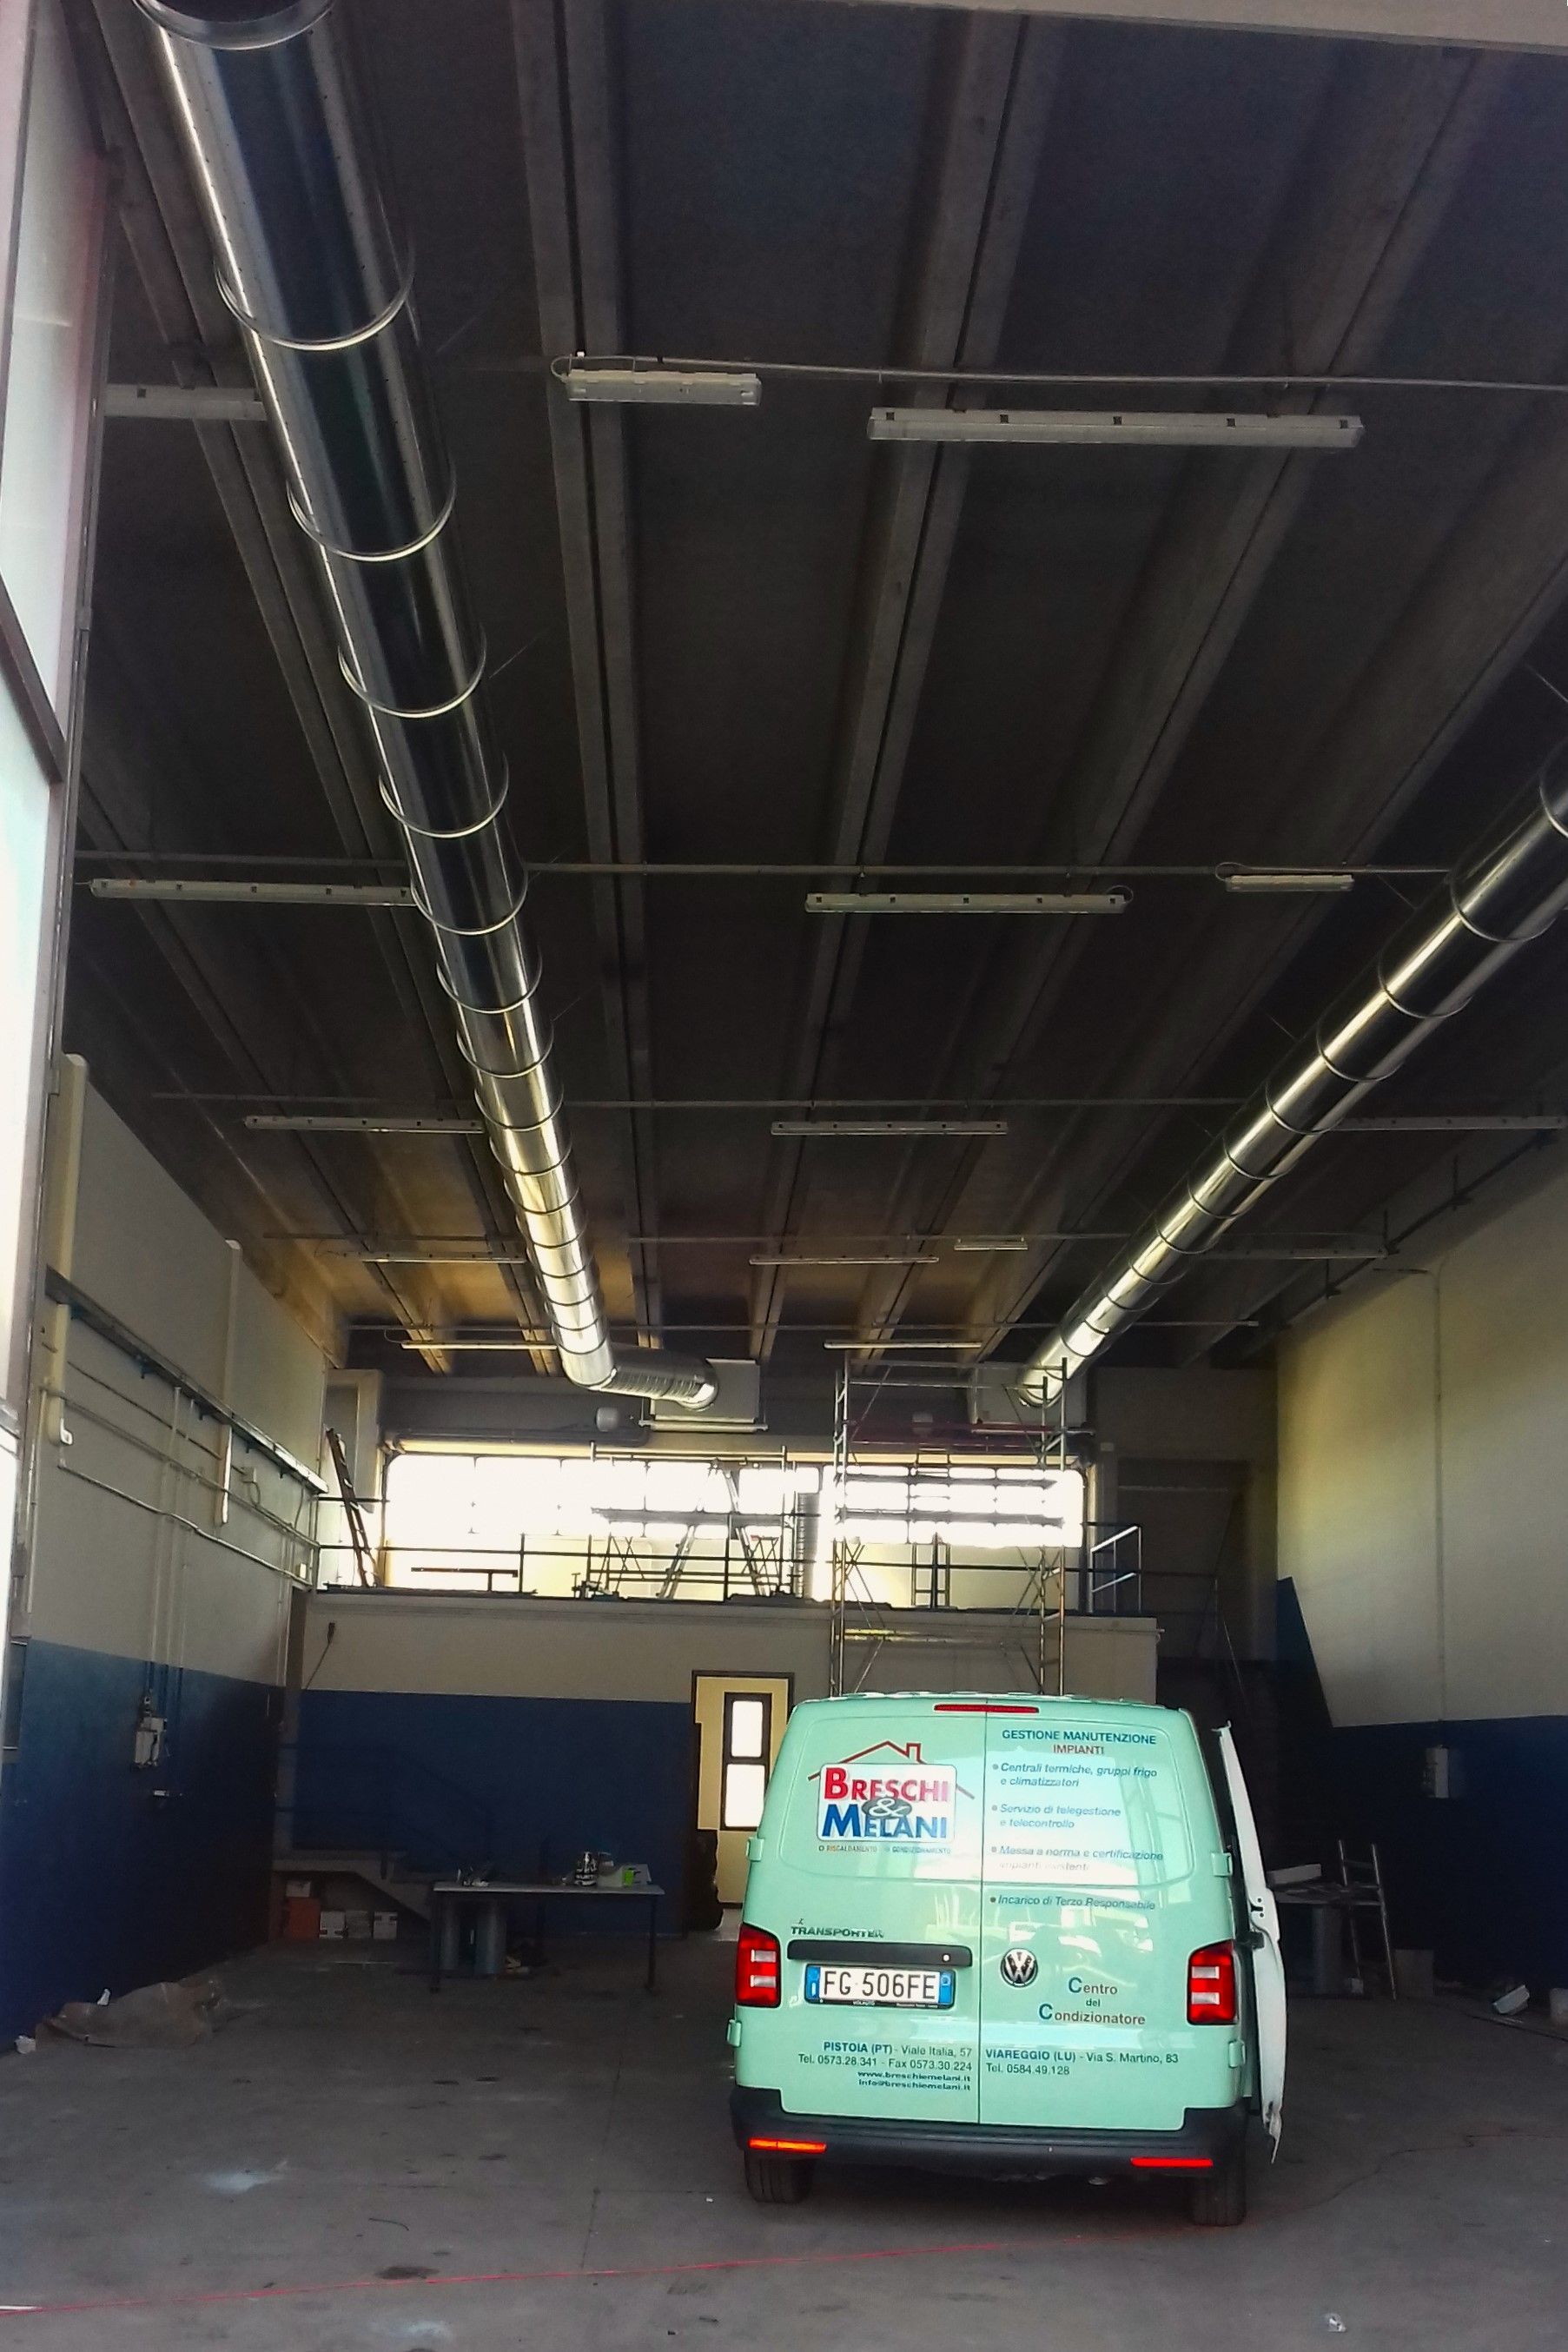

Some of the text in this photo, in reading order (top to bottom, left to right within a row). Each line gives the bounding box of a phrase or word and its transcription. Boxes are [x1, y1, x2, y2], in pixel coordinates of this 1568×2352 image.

[1002, 1730, 1157, 1745] GESTIONE MANUTENZIONE
[1053, 1744, 1105, 1755] IMPIANTI
[1001, 1762, 1157, 1779] Centrali termiche, gruppi frigo
[824, 1766, 949, 1802] BRESCHI
[1009, 1777, 1080, 1787] climatizzatori
[869, 1797, 907, 1818] &
[1000, 1804, 1121, 1817] Servizio di telegestione
[822, 1804, 948, 1839] MELANI
[1009, 1818, 1075, 1828] telecontrollo
[999, 1845, 1035, 1856] Messa
[1046, 1849, 1081, 1858] norma
[1093, 1848, 1163, 1861] certificazione
[998, 1895, 1155, 1910] Incarico di Terzo Responsabile
[824, 1971, 936, 1999] FG 506FE
[1068, 1977, 1118, 1995] Centro
[1086, 1998, 1101, 2007] del
[1039, 2004, 1146, 2025] Condizionatore
[824, 2042, 868, 2053] PISTOIA
[871, 2044, 893, 2056] (PT)
[901, 2045, 926, 2055] Viale
[929, 2046, 956, 2057] Italia,
[960, 2047, 972, 2057] 57
[986, 2049, 1050, 2060] VIAREGGIO
[1054, 2051, 1076, 2063] (LU)
[1086, 2052, 1103, 2063] Via
[1106, 2052, 1117, 2063] S.
[1120, 2053, 1163, 2064] Martino,
[1166, 2053, 1179, 2064] 83
[798, 2054, 815, 2064] Tel.
[817, 2055, 877, 2066] 0573.28.341
[888, 2058, 907, 2068] Fax
[857, 2071, 971, 2082] www.breschiemelani.it
[986, 2063, 1070, 2075] Tel. 0584.49.128
